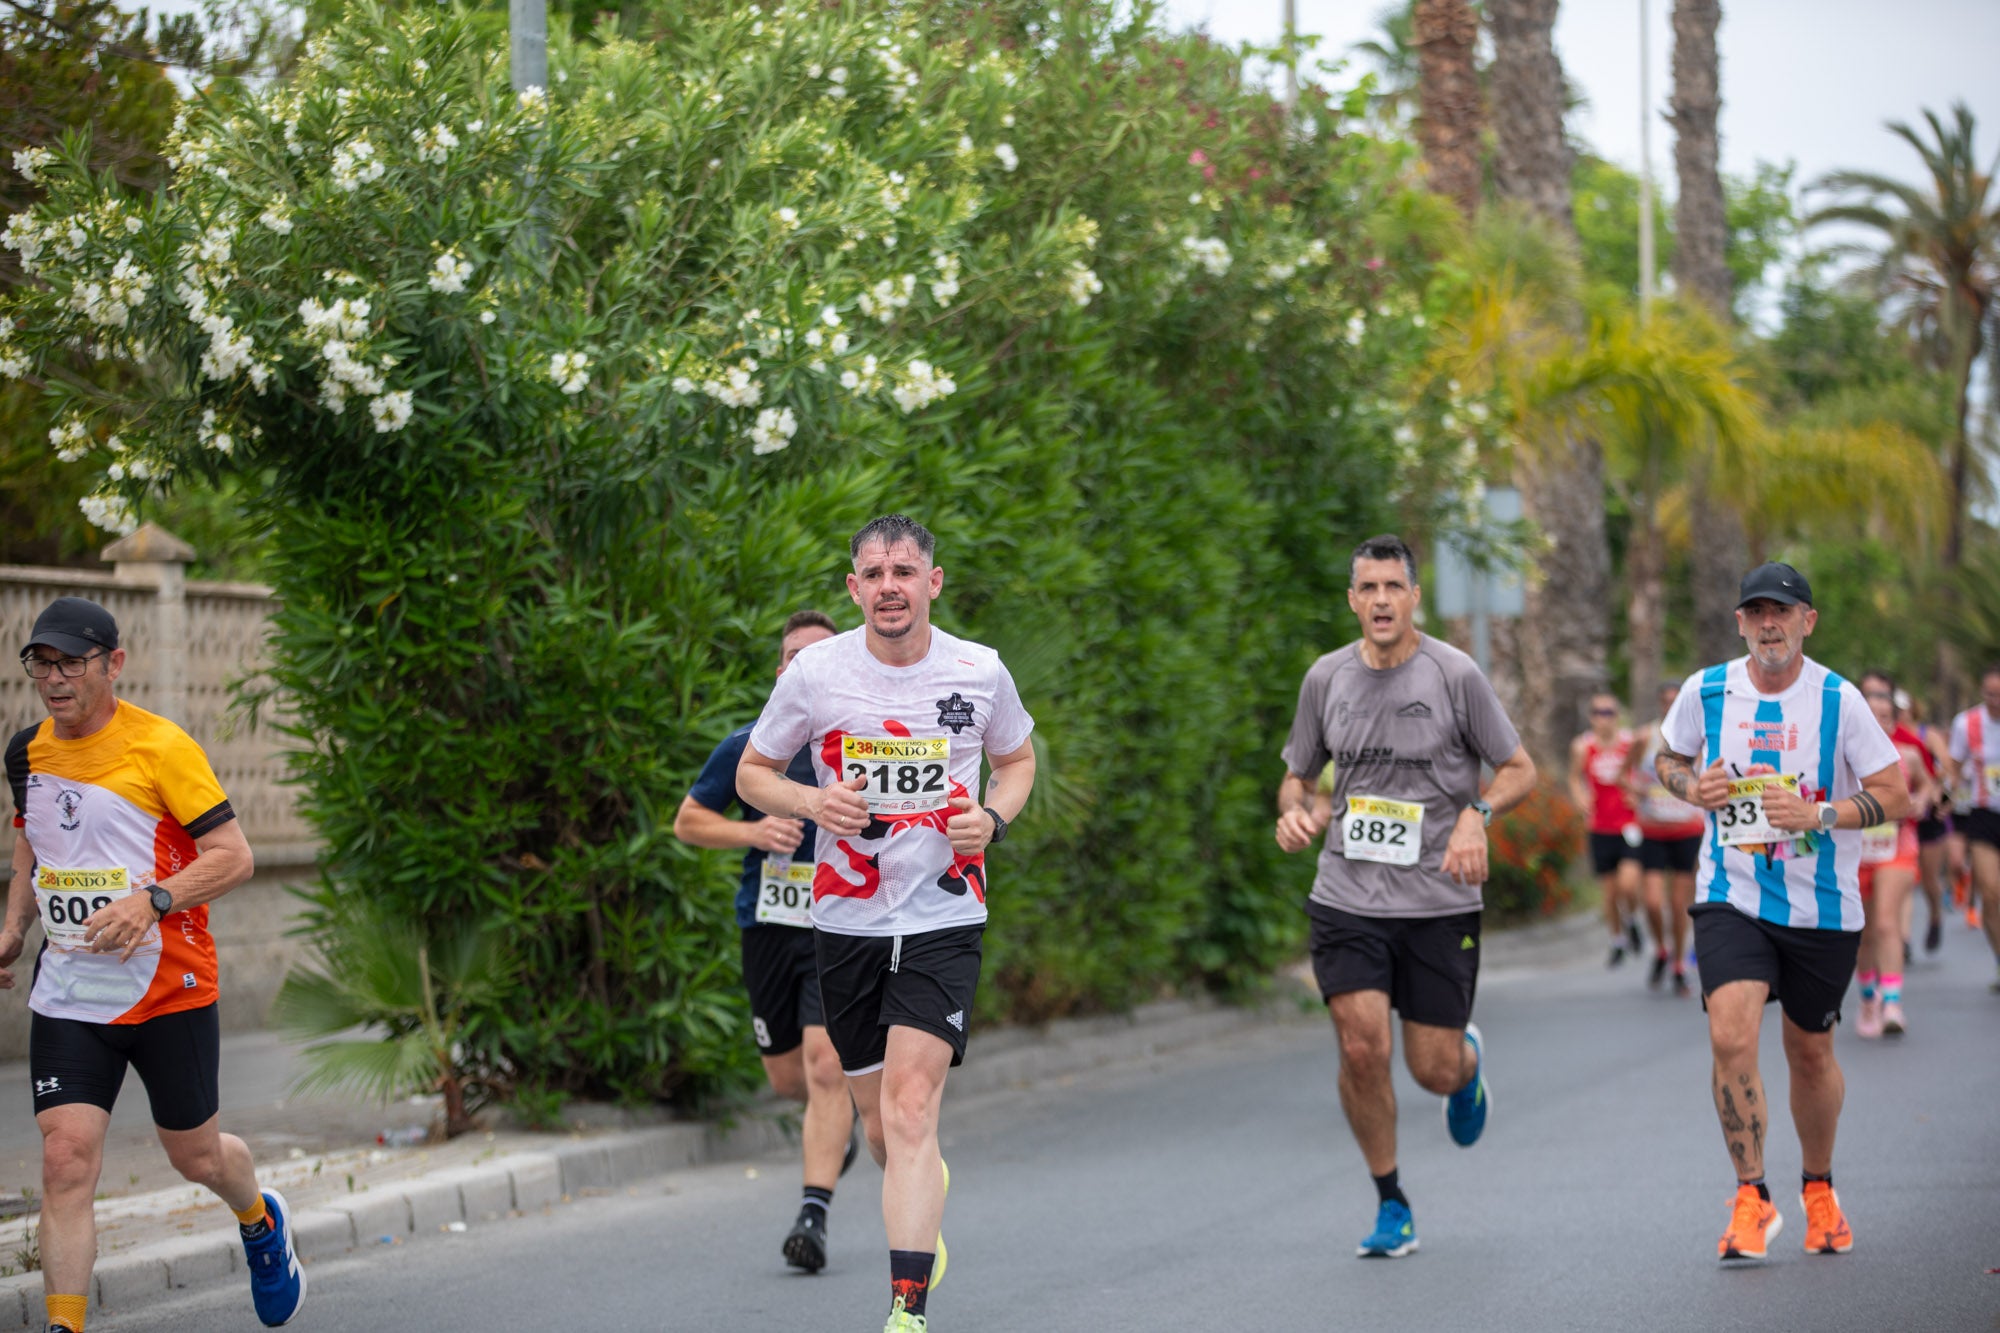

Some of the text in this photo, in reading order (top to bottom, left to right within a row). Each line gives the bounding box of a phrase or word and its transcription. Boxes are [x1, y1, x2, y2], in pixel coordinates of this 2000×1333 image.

[856, 741, 873, 754] 38
[873, 746, 928, 756] FONDO
[847, 763, 945, 794] 3182
[1720, 801, 1764, 827] 33
[1349, 819, 1407, 847] 882
[44, 872, 57, 885] 38
[56, 876, 107, 887] FONDO
[764, 884, 811, 910] 307
